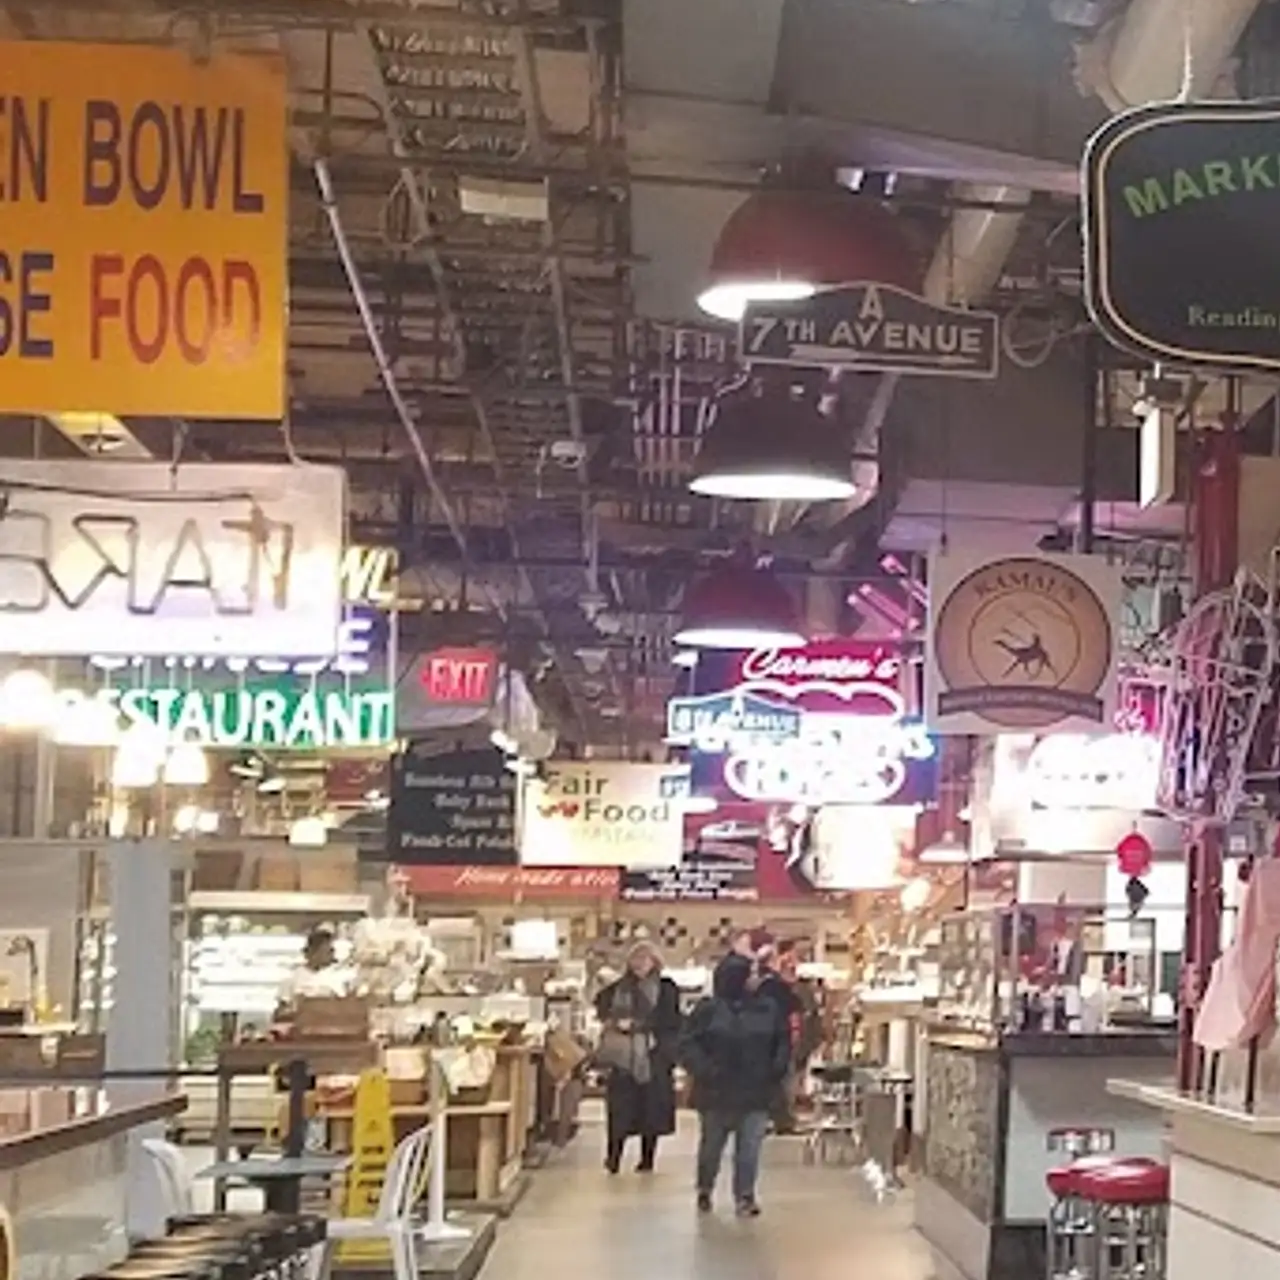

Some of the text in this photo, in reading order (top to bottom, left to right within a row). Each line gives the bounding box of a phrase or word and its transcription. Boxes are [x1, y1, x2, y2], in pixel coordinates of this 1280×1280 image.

[84, 100, 264, 213] BOWL
[90, 253, 261, 367] FOOD
[830, 319, 984, 354] AVENUE
[429, 658, 489, 699] EXIT
[742, 646, 900, 680] Carmen's
[544, 770, 609, 796] Fair
[584, 797, 671, 824] Food
